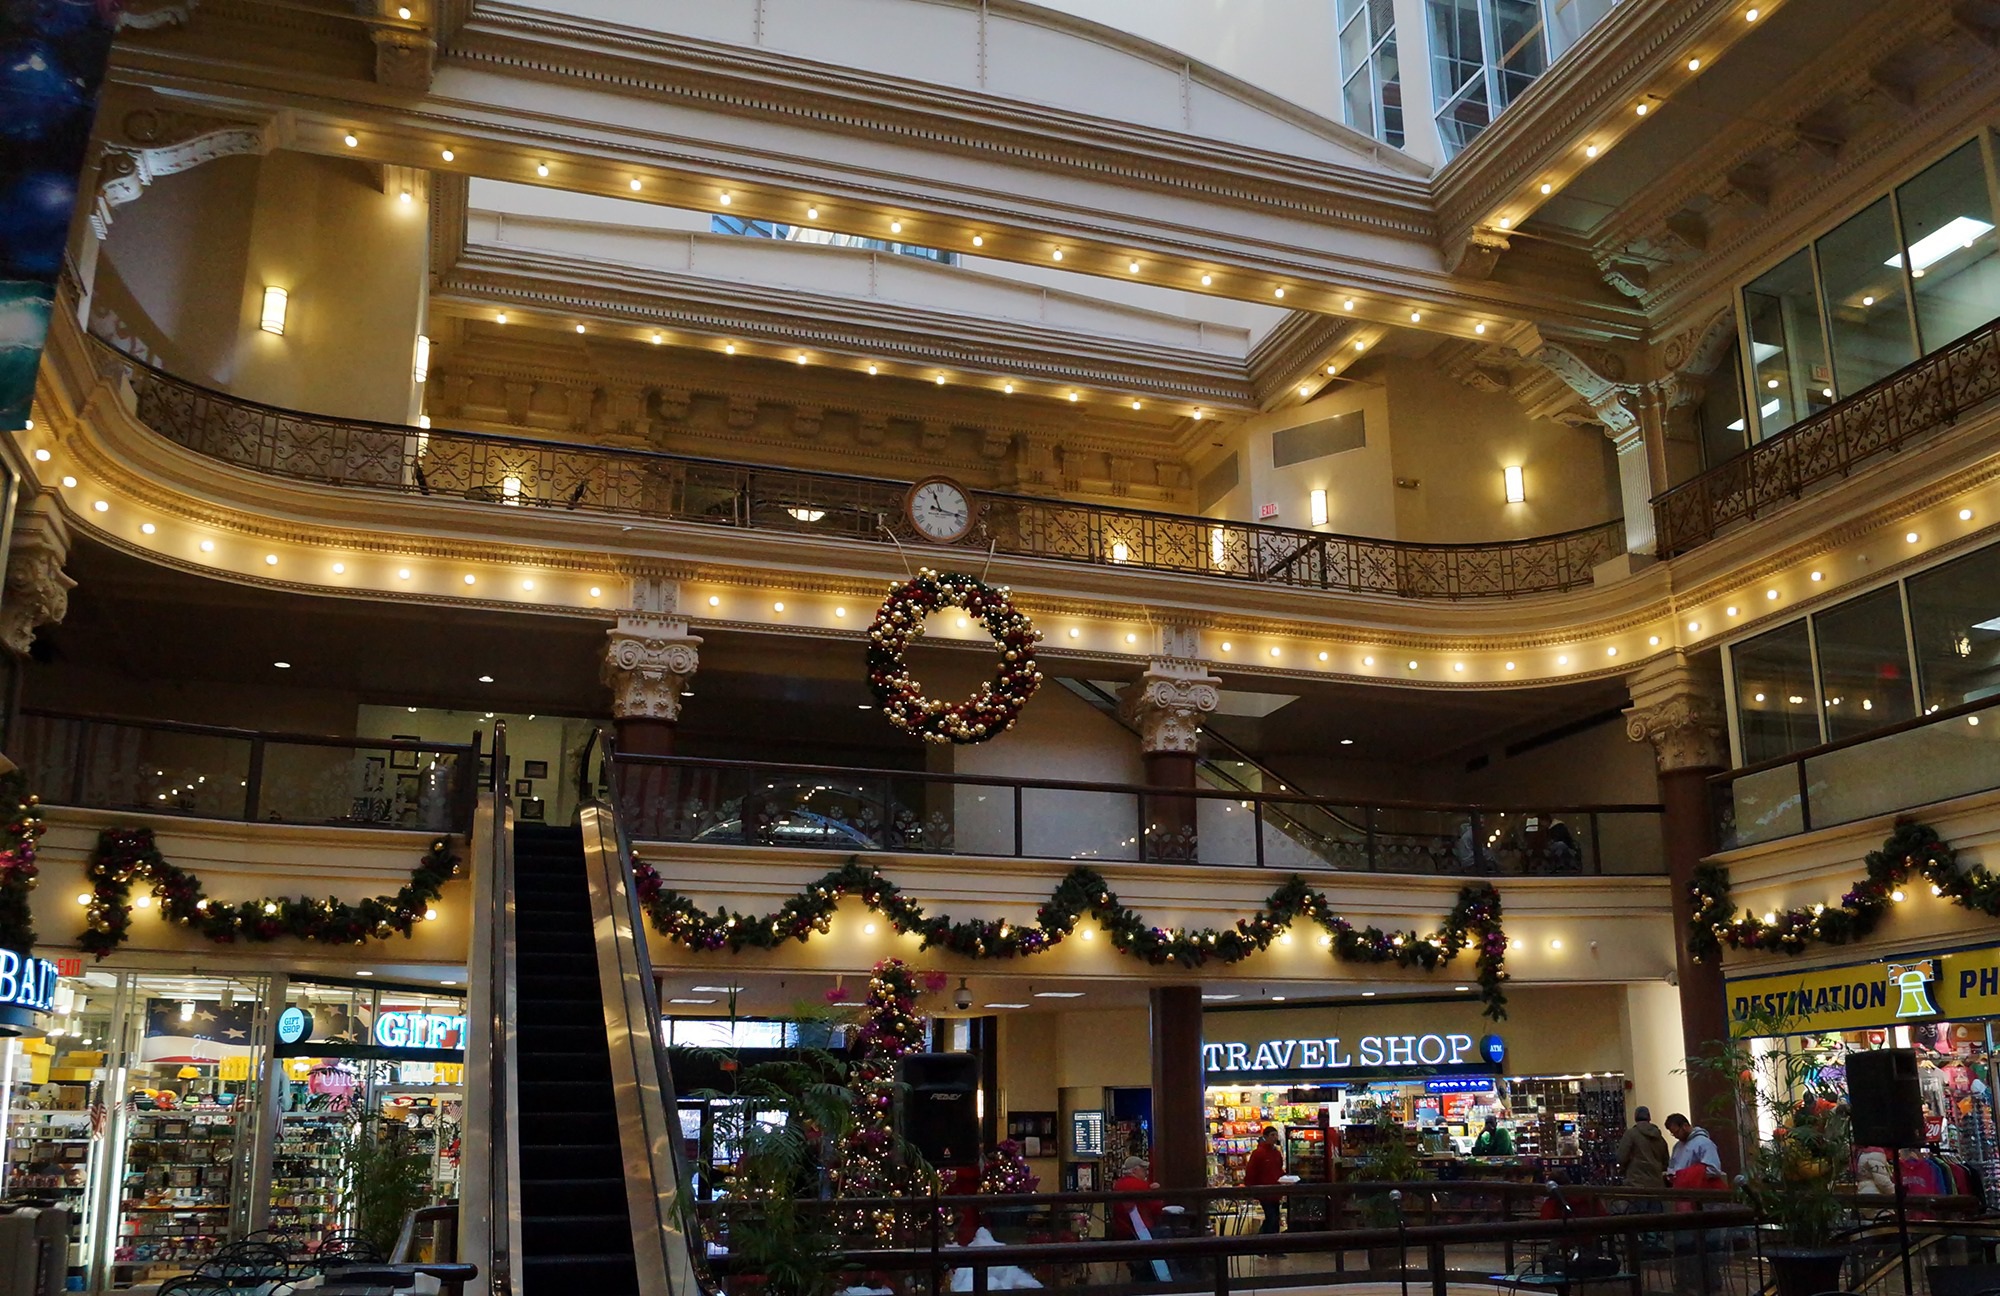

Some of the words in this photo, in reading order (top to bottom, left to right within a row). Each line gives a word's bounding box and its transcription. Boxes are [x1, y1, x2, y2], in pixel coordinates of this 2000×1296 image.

[1262, 504, 1275, 516] EXIT
[57, 958, 81, 976] EXIT
[284, 1016, 300, 1025] GIFT
[282, 1024, 301, 1034] SHOP
[1203, 1038, 1351, 1071] TRAVEL
[1360, 1034, 1472, 1066] SHOP
[1489, 1044, 1503, 1052] ATM
